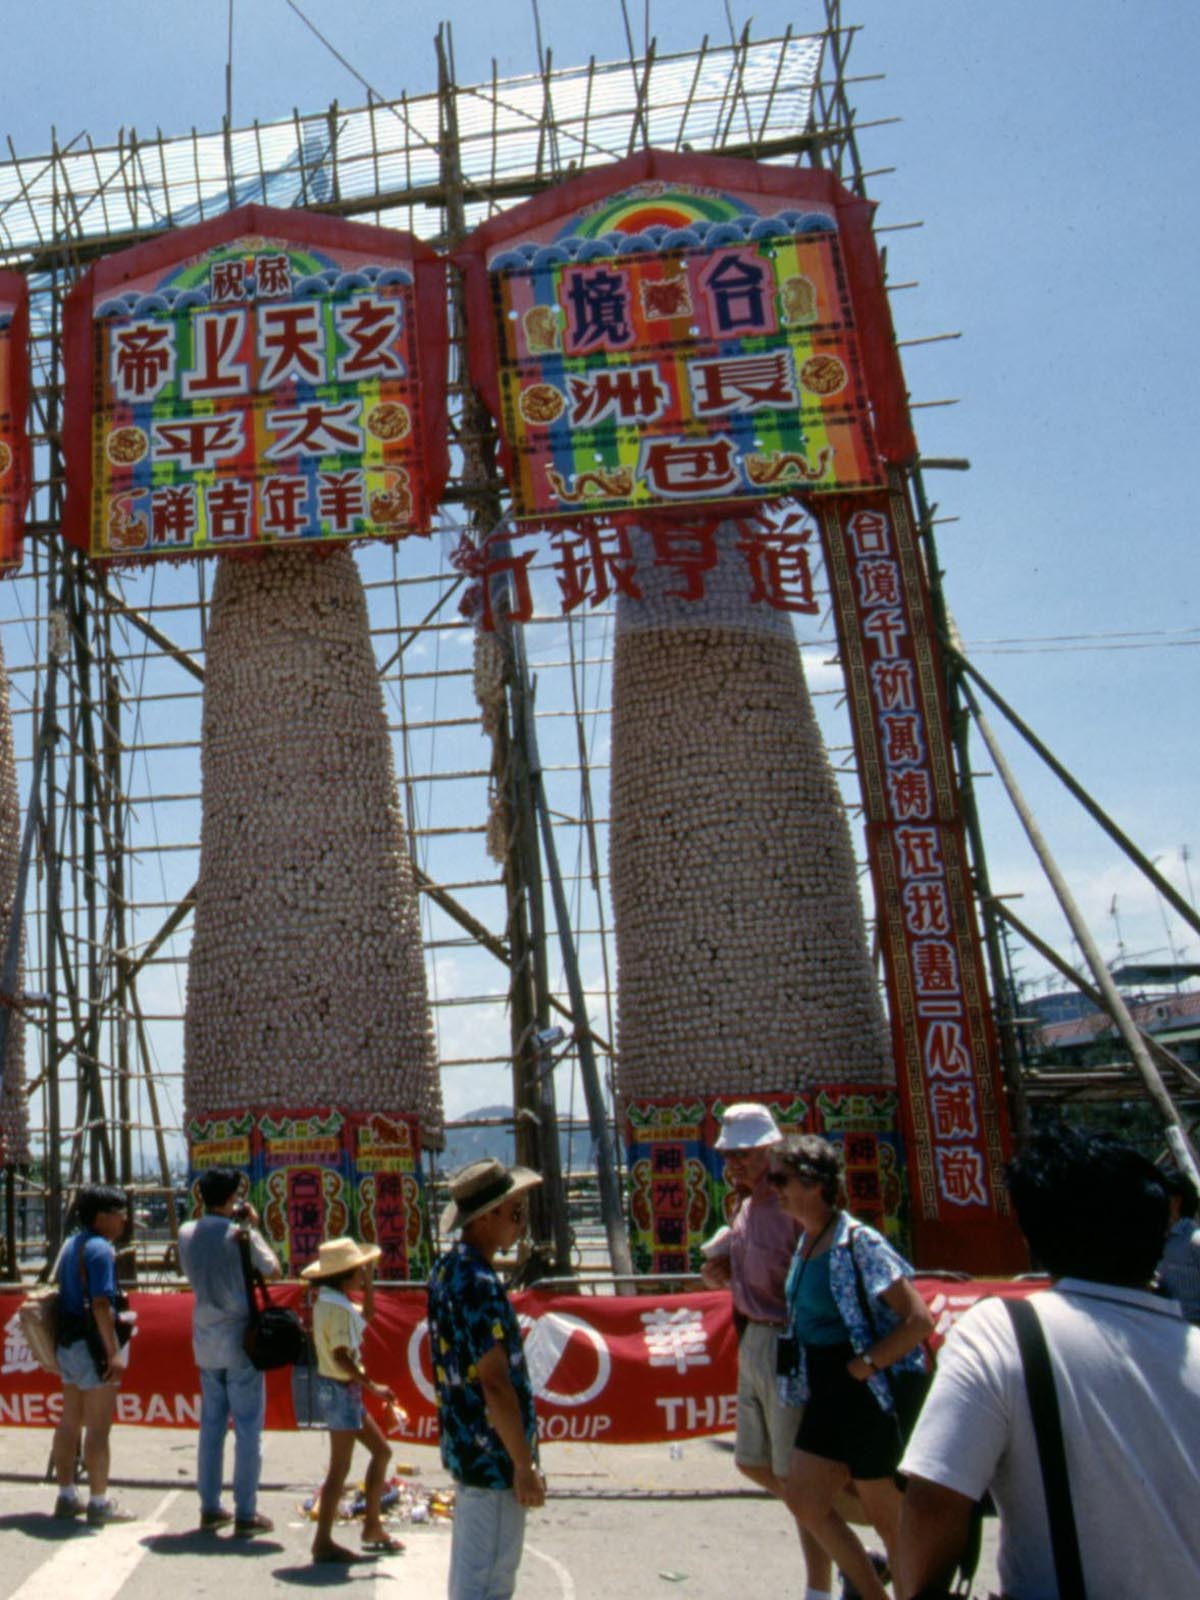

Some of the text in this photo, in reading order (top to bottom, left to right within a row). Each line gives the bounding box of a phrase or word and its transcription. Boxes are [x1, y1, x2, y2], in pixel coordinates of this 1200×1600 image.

[116, 298, 398, 398] 玄天上帝
[570, 356, 795, 424] 長洲
[155, 403, 360, 465] 太平
[644, 440, 738, 492] 包
[152, 470, 365, 542] 羊年吉祥
[641, 1308, 710, 1374] 華
[116, 1393, 201, 1425] BAN
[537, 1415, 612, 1439] ROUP
